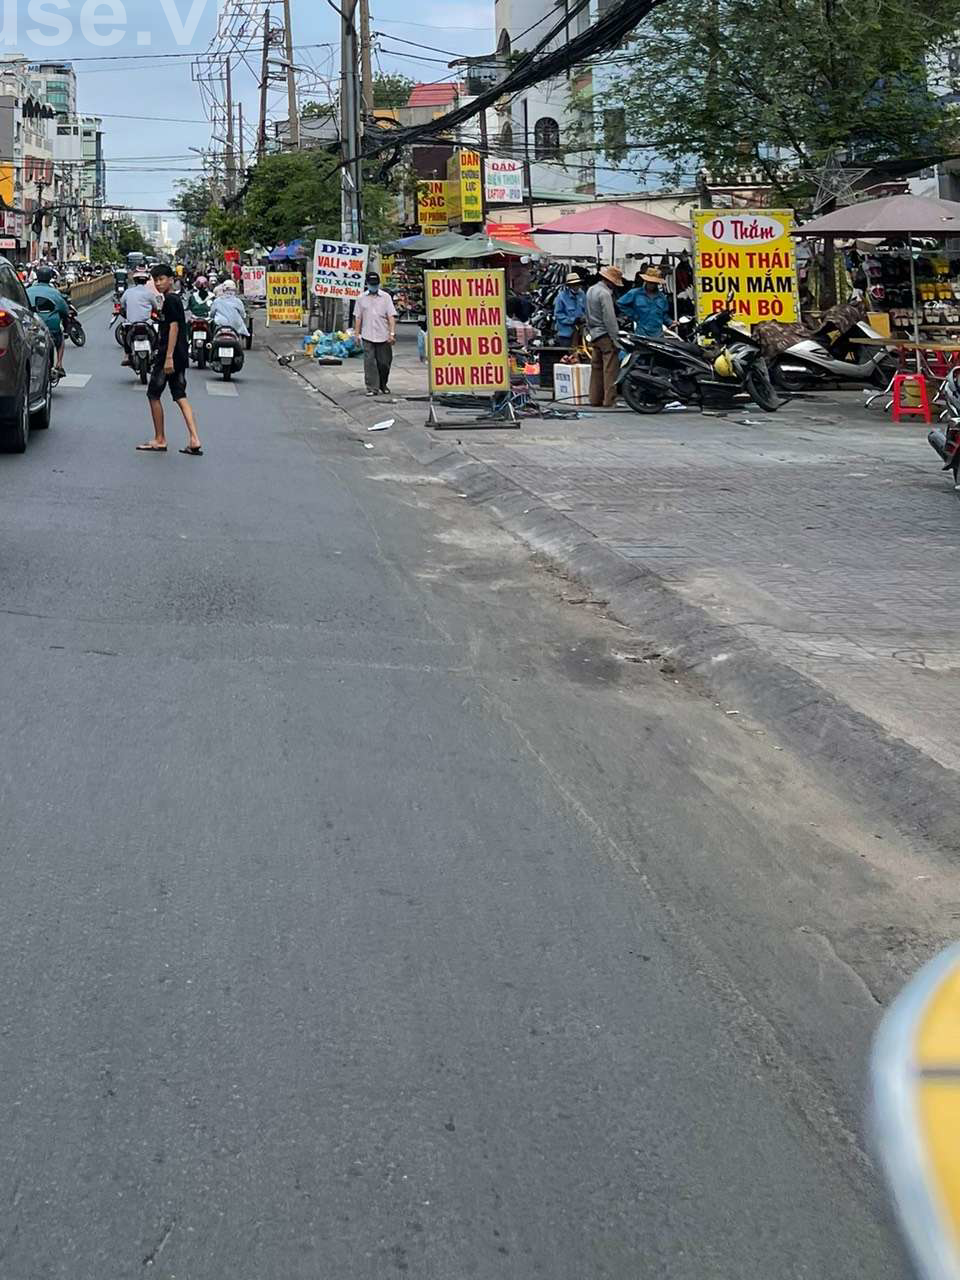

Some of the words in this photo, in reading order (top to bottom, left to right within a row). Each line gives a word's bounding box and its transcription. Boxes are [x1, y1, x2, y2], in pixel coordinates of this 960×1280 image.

[317, 255, 340, 269] VALI
[701, 248, 740, 269] BÚN
[745, 247, 790, 269] THÁI
[431, 274, 462, 297] BÚN
[466, 273, 500, 297] THÁI
[701, 271, 740, 293] BÚN
[746, 269, 792, 293] MẮM
[433, 303, 462, 327] BÚN
[465, 300, 501, 327] MẮM
[757, 294, 784, 317] BÒ
[434, 332, 472, 356] BÚN
[478, 331, 503, 356] BÒ
[435, 362, 466, 386] BÚN
[470, 361, 504, 385] RIÊU
